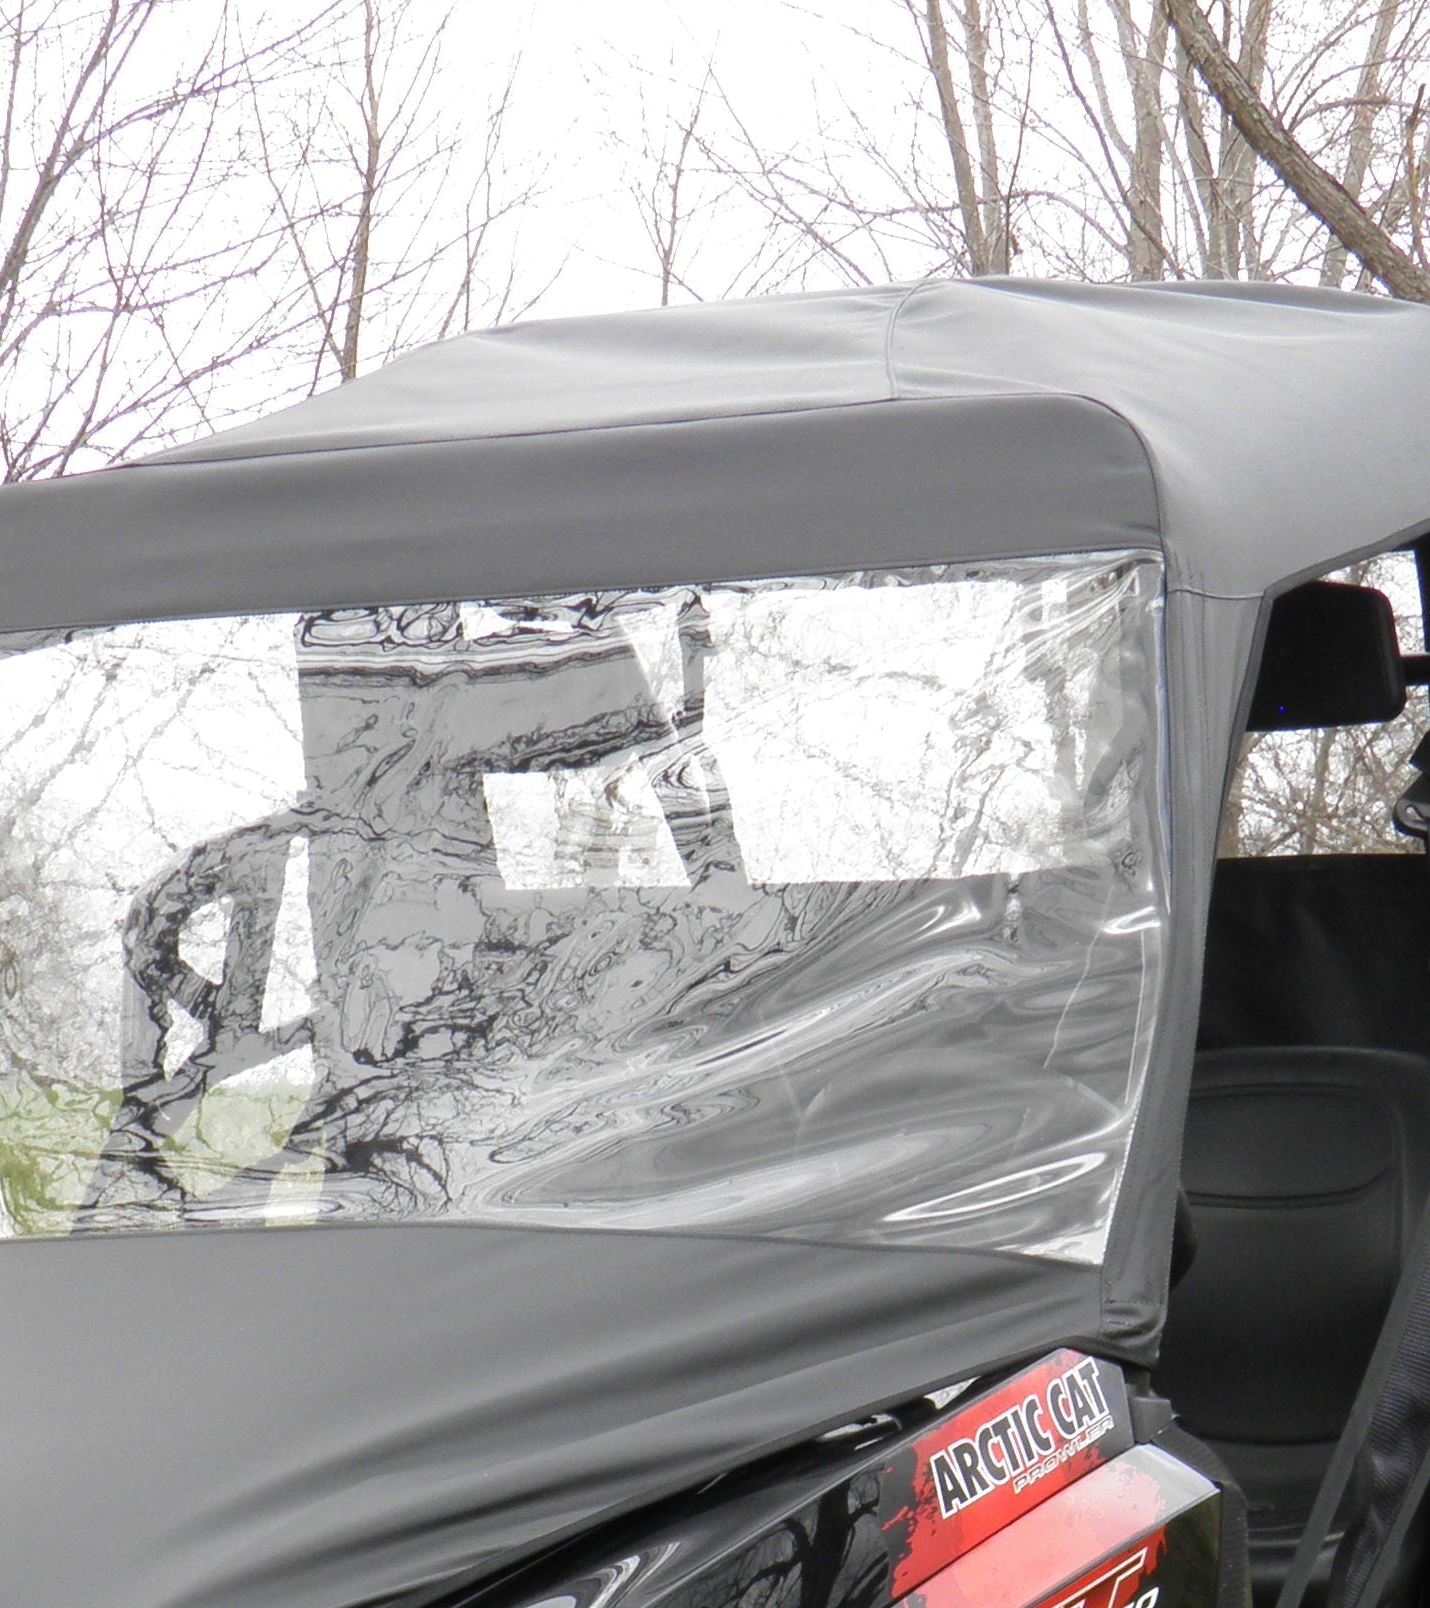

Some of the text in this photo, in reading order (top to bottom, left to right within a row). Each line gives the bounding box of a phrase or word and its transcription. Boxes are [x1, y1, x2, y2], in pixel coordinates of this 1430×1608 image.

[929, 1356, 1110, 1519] ARCTIC CAT
[1013, 1415, 1114, 1494] PROWLER
